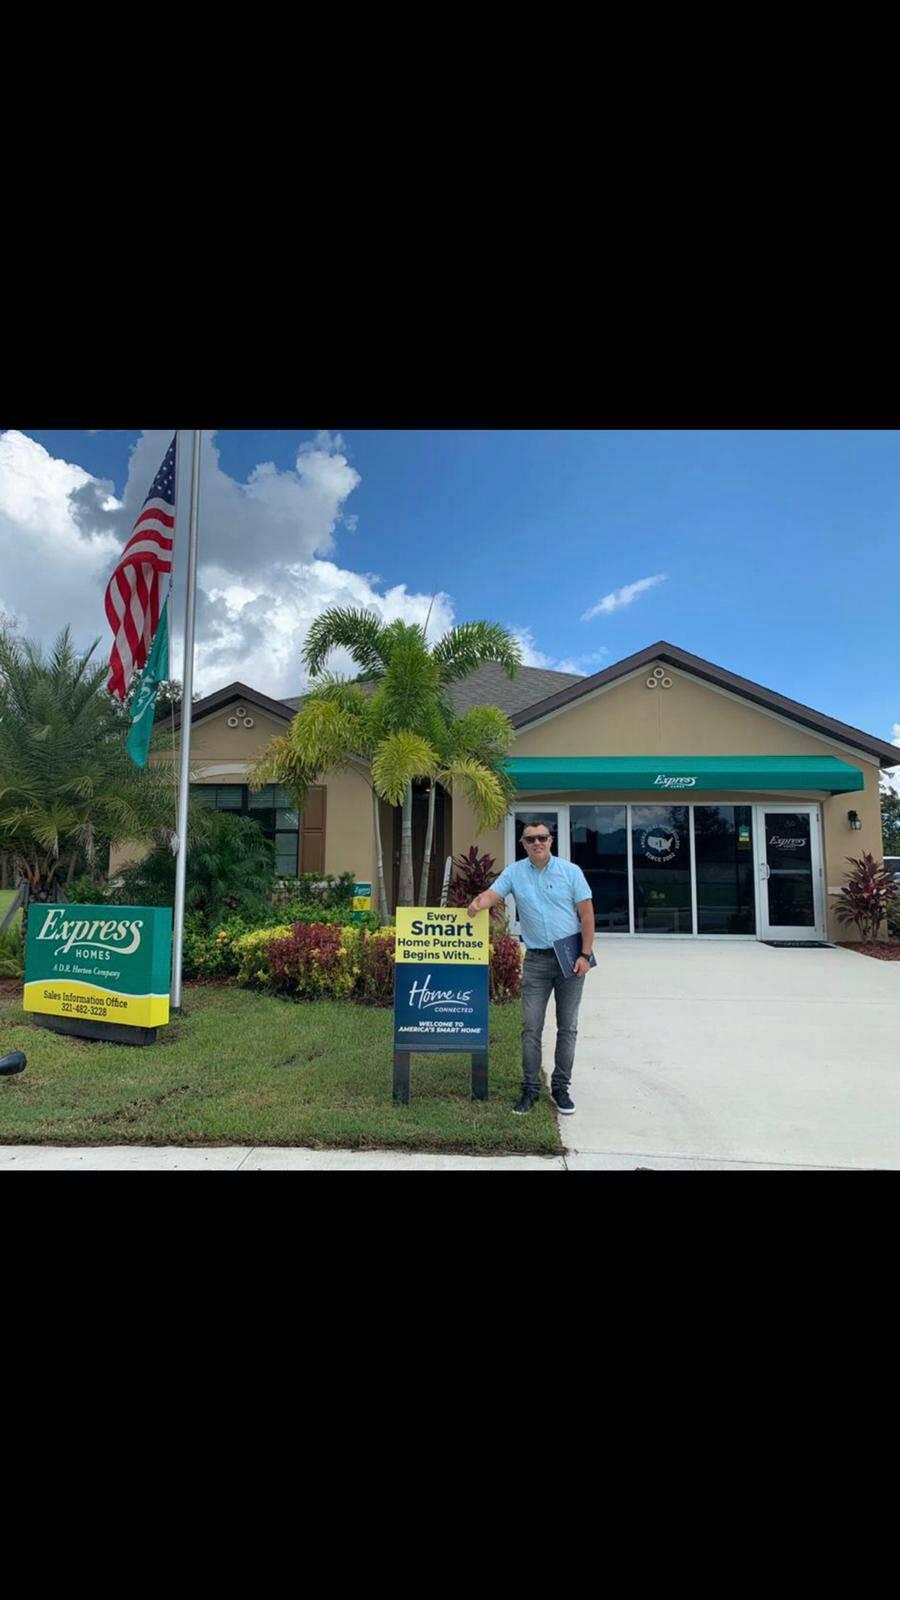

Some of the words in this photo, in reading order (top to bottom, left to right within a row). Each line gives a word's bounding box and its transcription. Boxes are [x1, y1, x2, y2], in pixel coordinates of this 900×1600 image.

[652, 774, 697, 787] Express
[426, 911, 458, 923] Every
[36, 909, 144, 956] Express
[411, 920, 473, 936] Smart
[397, 938, 430, 947] Home
[432, 938, 483, 948] Purchase
[75, 949, 111, 960] HOMES
[403, 949, 440, 961] Begins
[72, 965, 92, 975] Horton
[93, 966, 121, 980] Company
[409, 974, 453, 1009] Home
[456, 989, 472, 1001] is
[43, 990, 61, 1000] Sales
[62, 992, 104, 1006] Information
[105, 997, 128, 1009] Office
[61, 1003, 107, 1017] 321-482-3228
